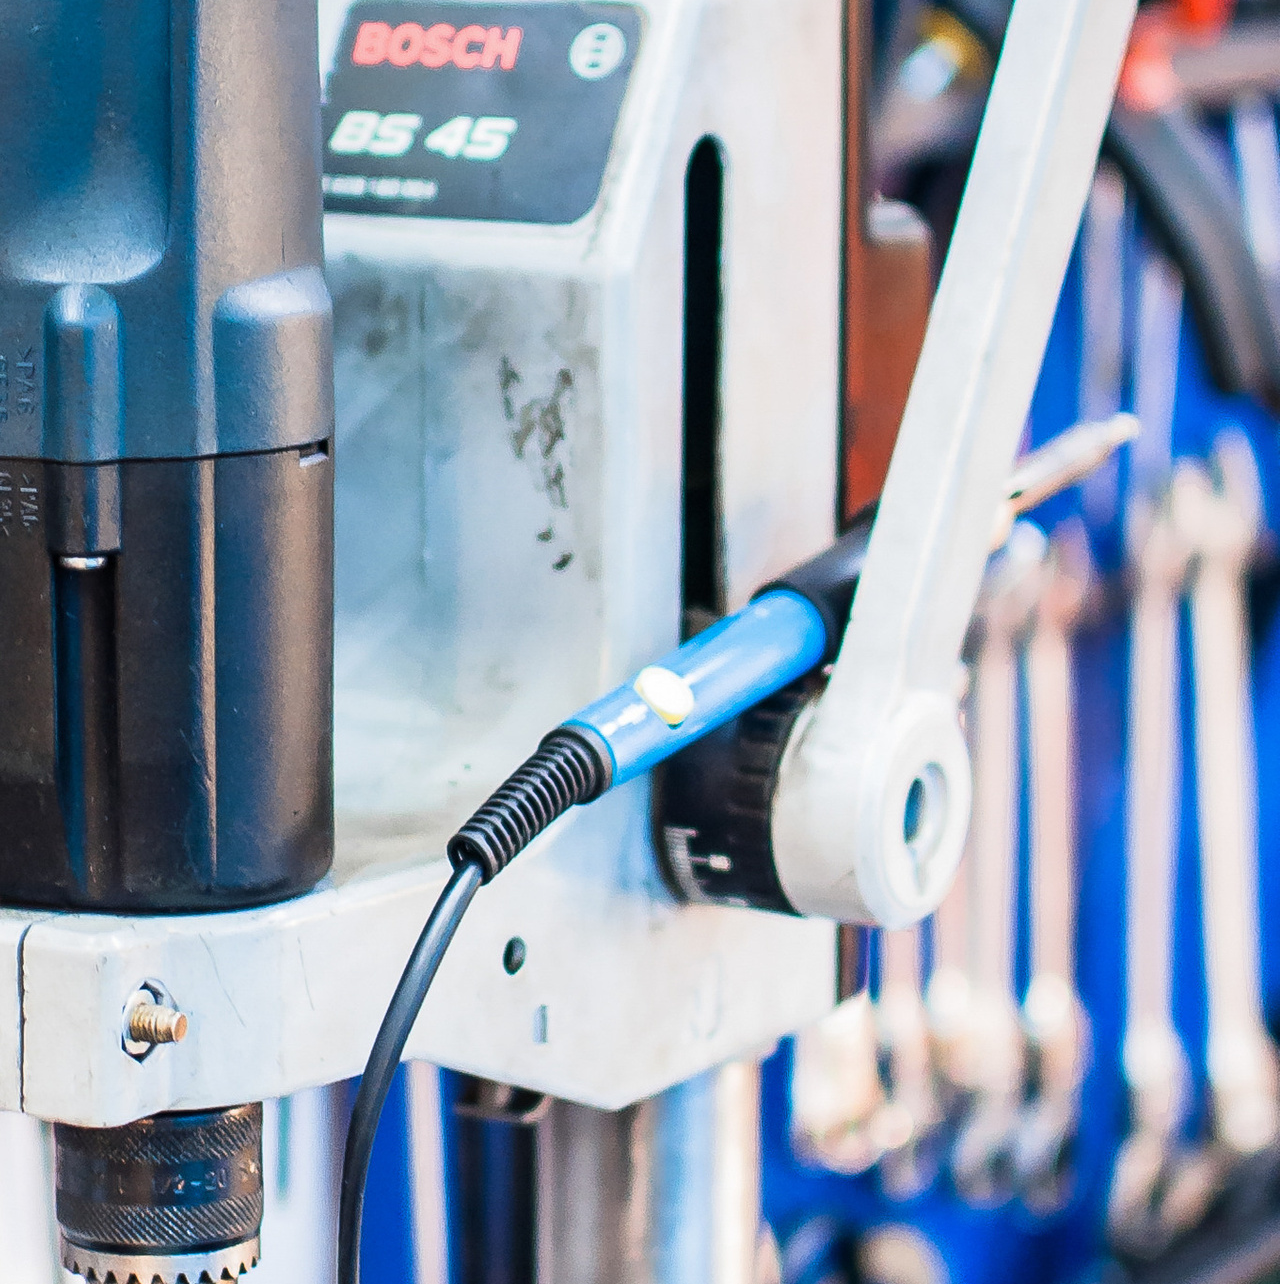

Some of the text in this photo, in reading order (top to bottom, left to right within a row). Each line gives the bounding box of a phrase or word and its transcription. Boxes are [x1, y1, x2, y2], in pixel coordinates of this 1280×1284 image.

[352, 21, 523, 71] BOSCH
[328, 110, 519, 161] BS 45
